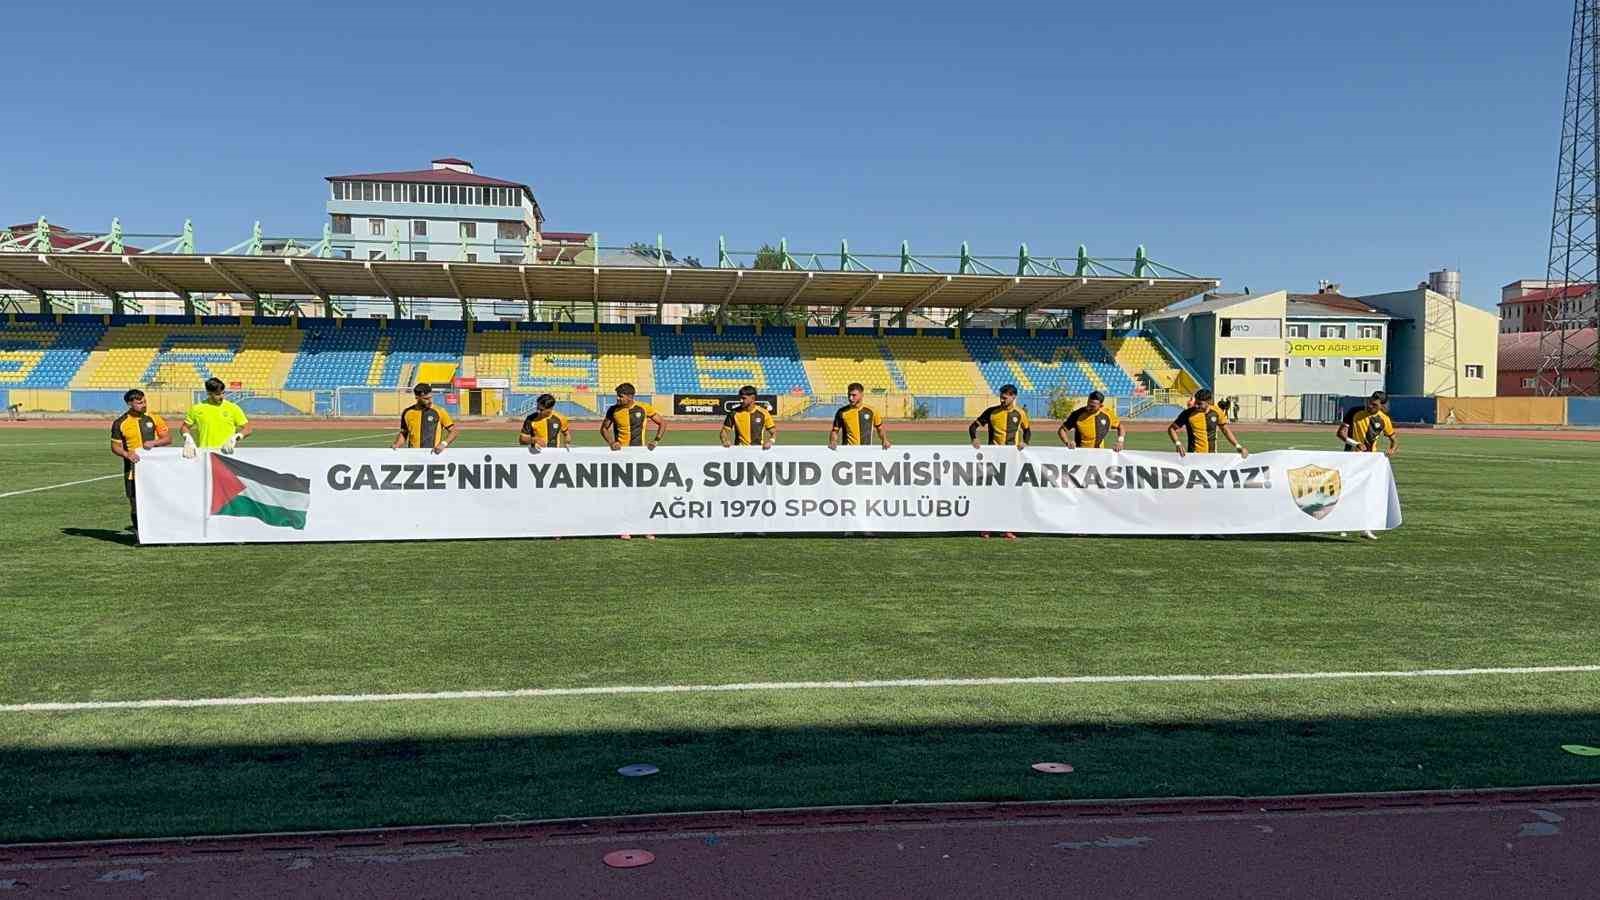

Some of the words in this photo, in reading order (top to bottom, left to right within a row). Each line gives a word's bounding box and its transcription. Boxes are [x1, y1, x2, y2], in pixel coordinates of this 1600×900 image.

[528, 463, 693, 492] YANINDA,
[704, 462, 822, 487] SUMUD
[1015, 463, 1272, 489] ARKASINDAYIZ!
[650, 496, 711, 518] AĞRI
[720, 500, 776, 517] 1970
[786, 499, 856, 517] SPOR
[866, 495, 969, 517] KULÜBÜ
